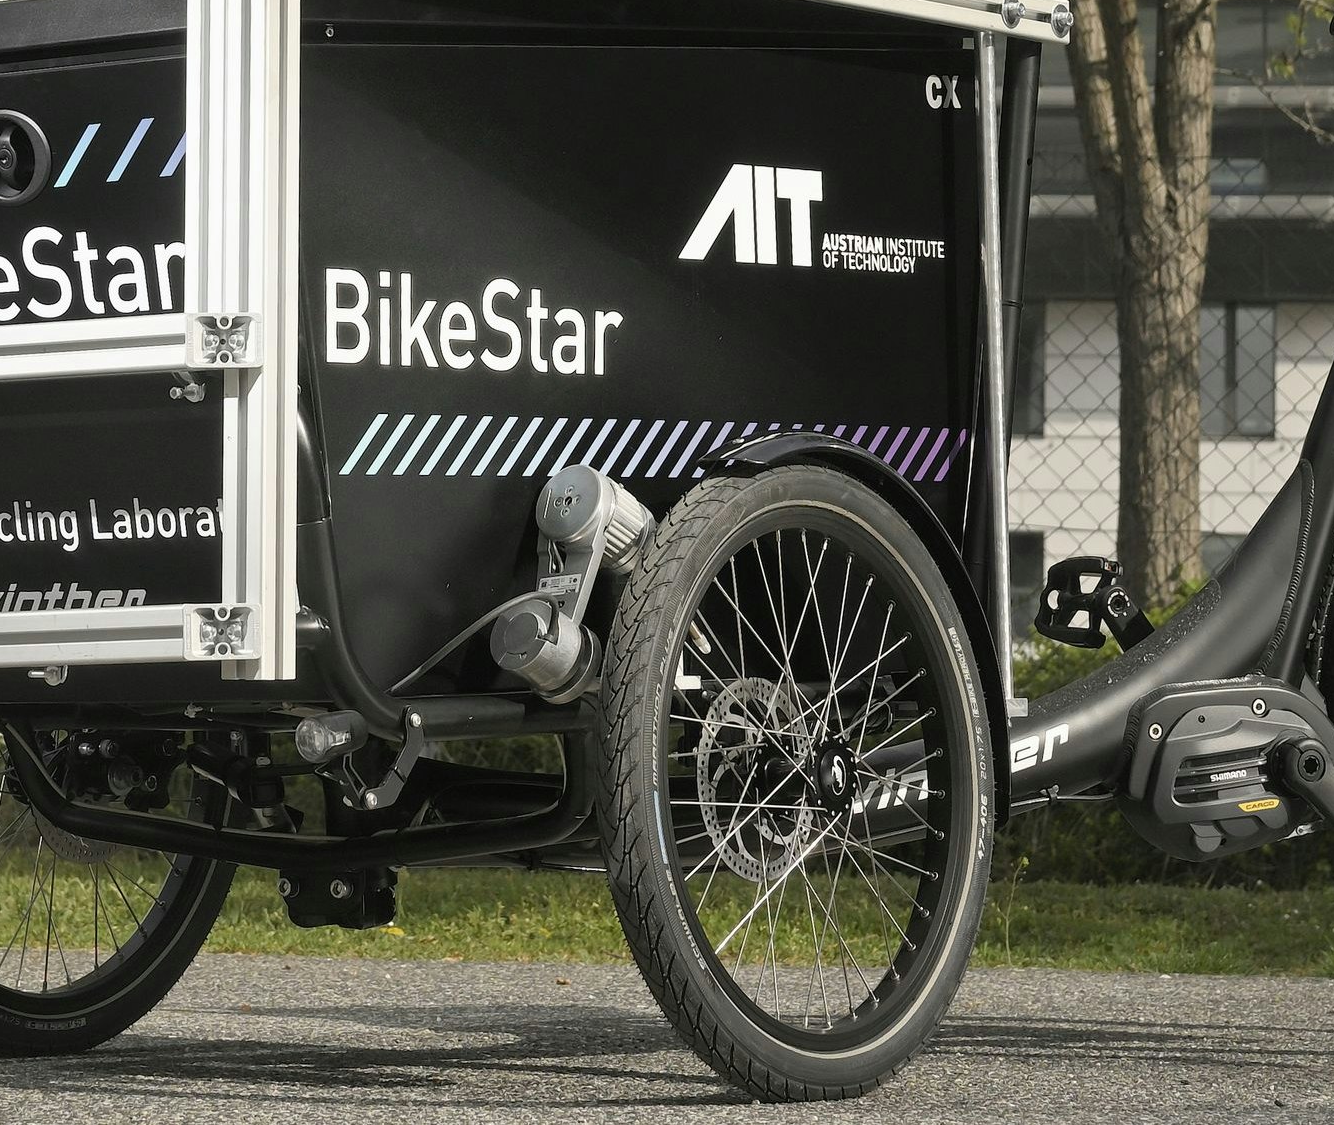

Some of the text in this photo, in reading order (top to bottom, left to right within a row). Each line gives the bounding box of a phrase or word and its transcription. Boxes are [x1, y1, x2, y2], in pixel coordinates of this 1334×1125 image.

[678, 163, 823, 266] AIT
[821, 232, 945, 259] AUSTRIAN INSTITUTE
[822, 250, 916, 274] OF TECHNOLOGY
[323, 267, 624, 375] BikeStar
[1210, 769, 1247, 783] SHIMANO
[1245, 799, 1275, 811] CARGO
